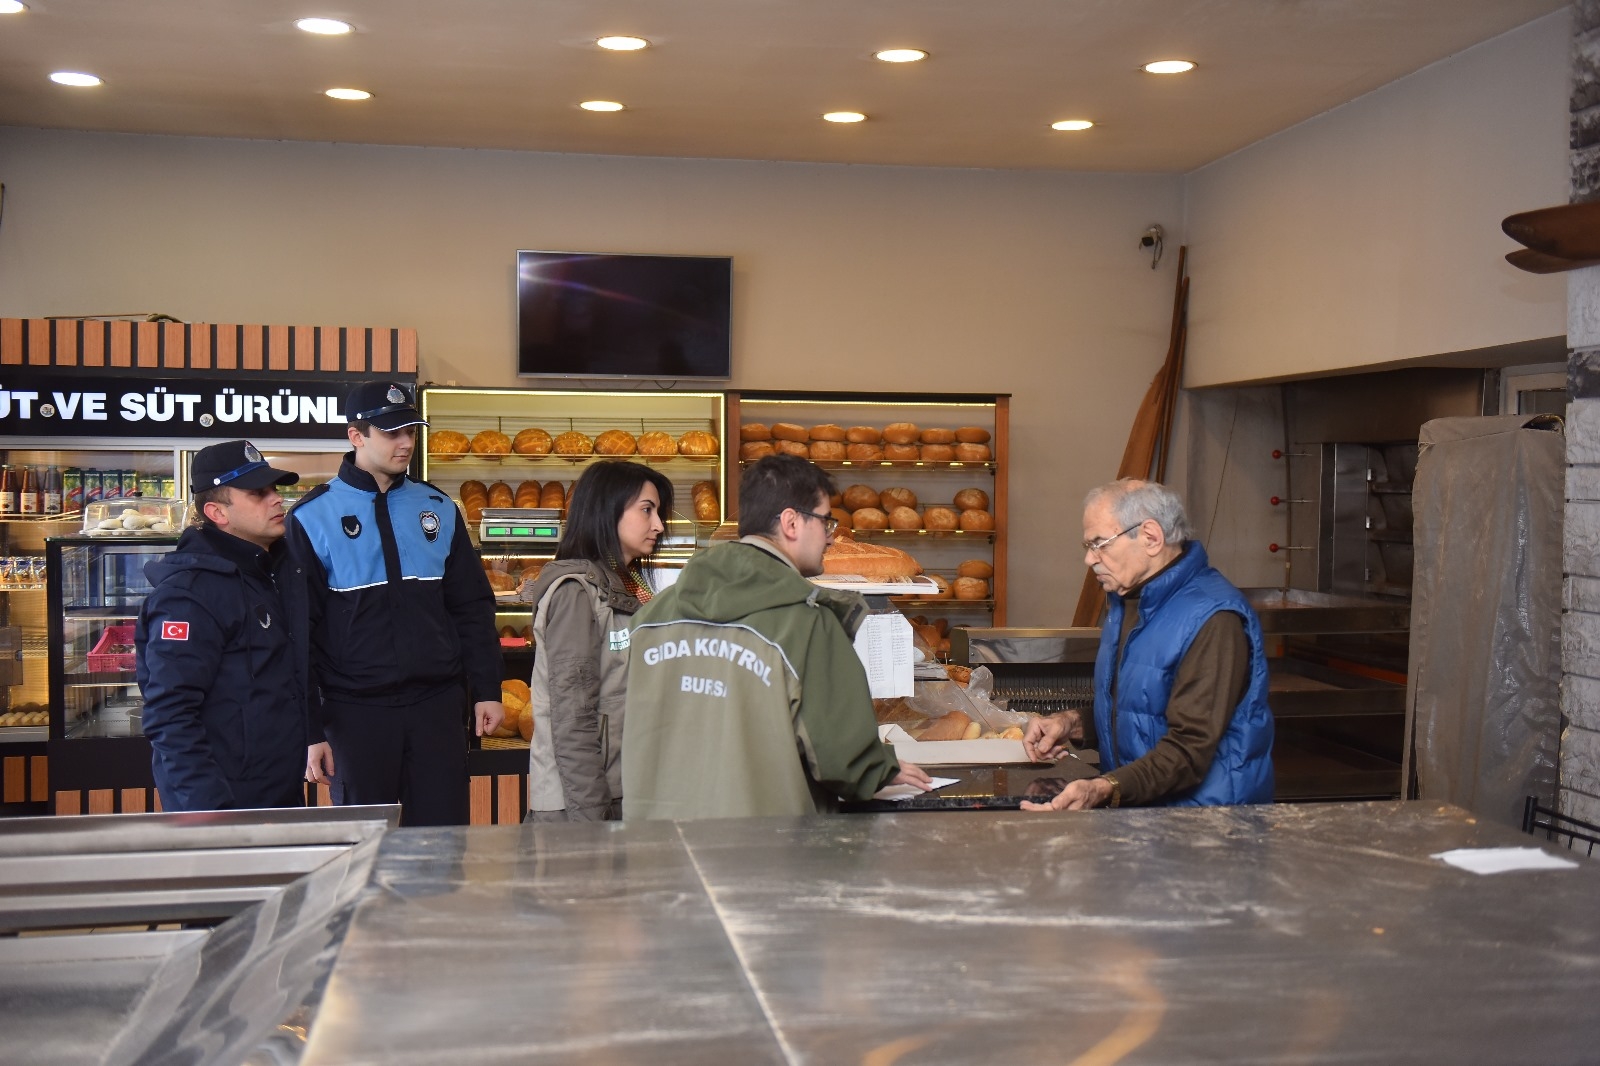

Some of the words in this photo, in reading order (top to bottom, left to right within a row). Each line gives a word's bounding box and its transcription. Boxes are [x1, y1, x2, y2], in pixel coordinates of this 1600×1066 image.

[52, 392, 108, 420] VE
[120, 386, 202, 422] SÜT
[215, 388, 348, 424] ÜRÜNL
[643, 640, 692, 666] GIDA
[695, 638, 772, 687] KONTROL
